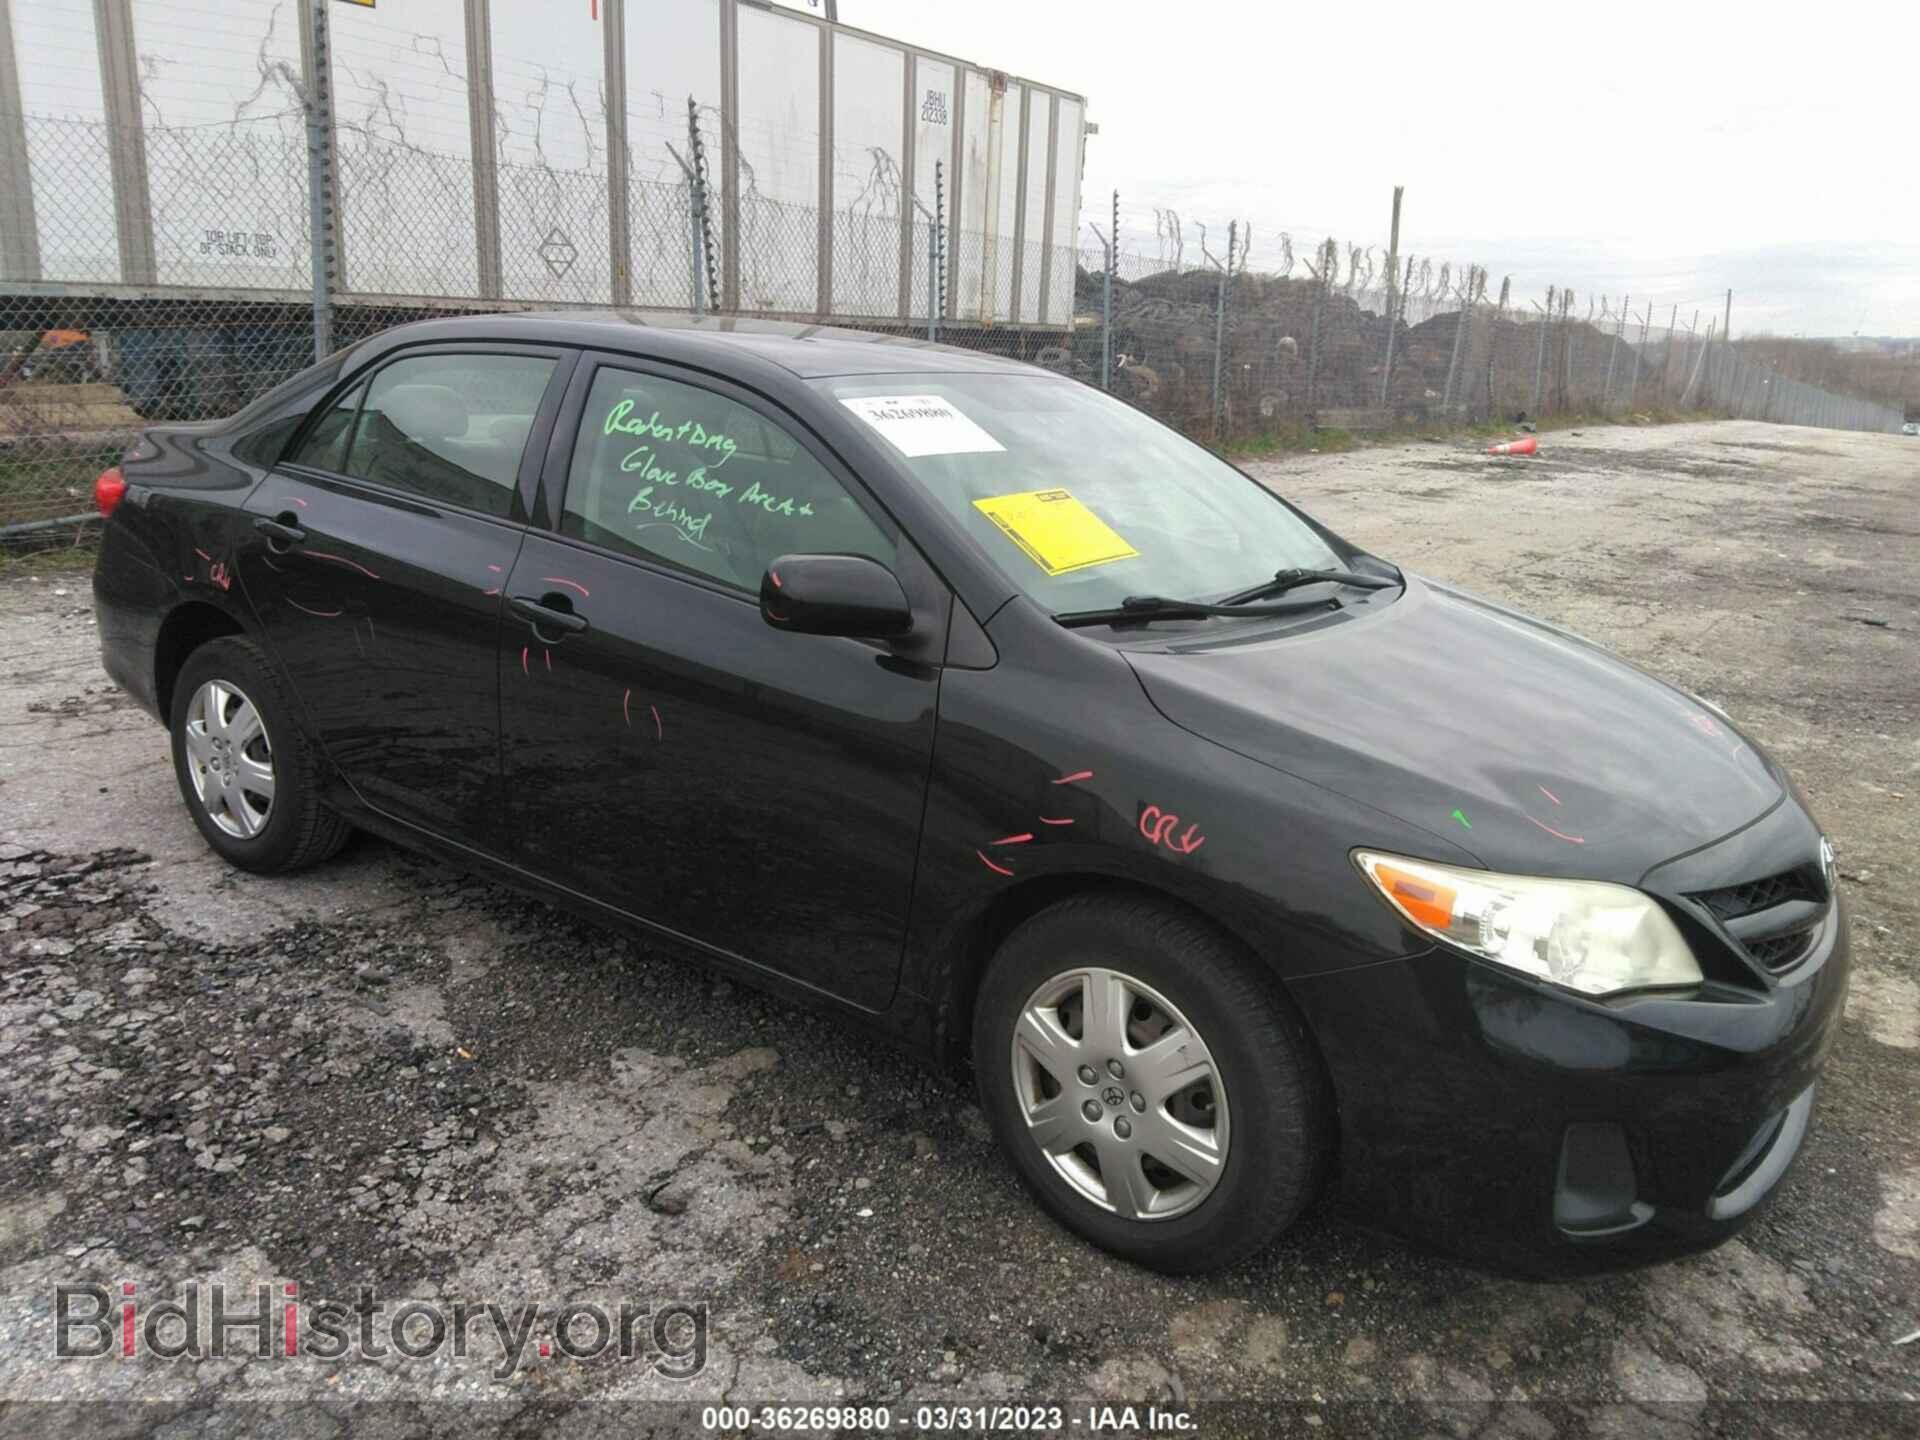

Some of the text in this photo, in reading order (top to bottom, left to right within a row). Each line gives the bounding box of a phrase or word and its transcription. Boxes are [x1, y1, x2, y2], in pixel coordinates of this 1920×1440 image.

[923, 90, 946, 107] JBHU
[205, 230, 224, 242] TOP
[227, 231, 247, 244] LIFT
[199, 242, 277, 258] OF STACK ONLY
[620, 446, 680, 486] Glove
[685, 466, 735, 499] Box
[627, 486, 713, 540] Behind
